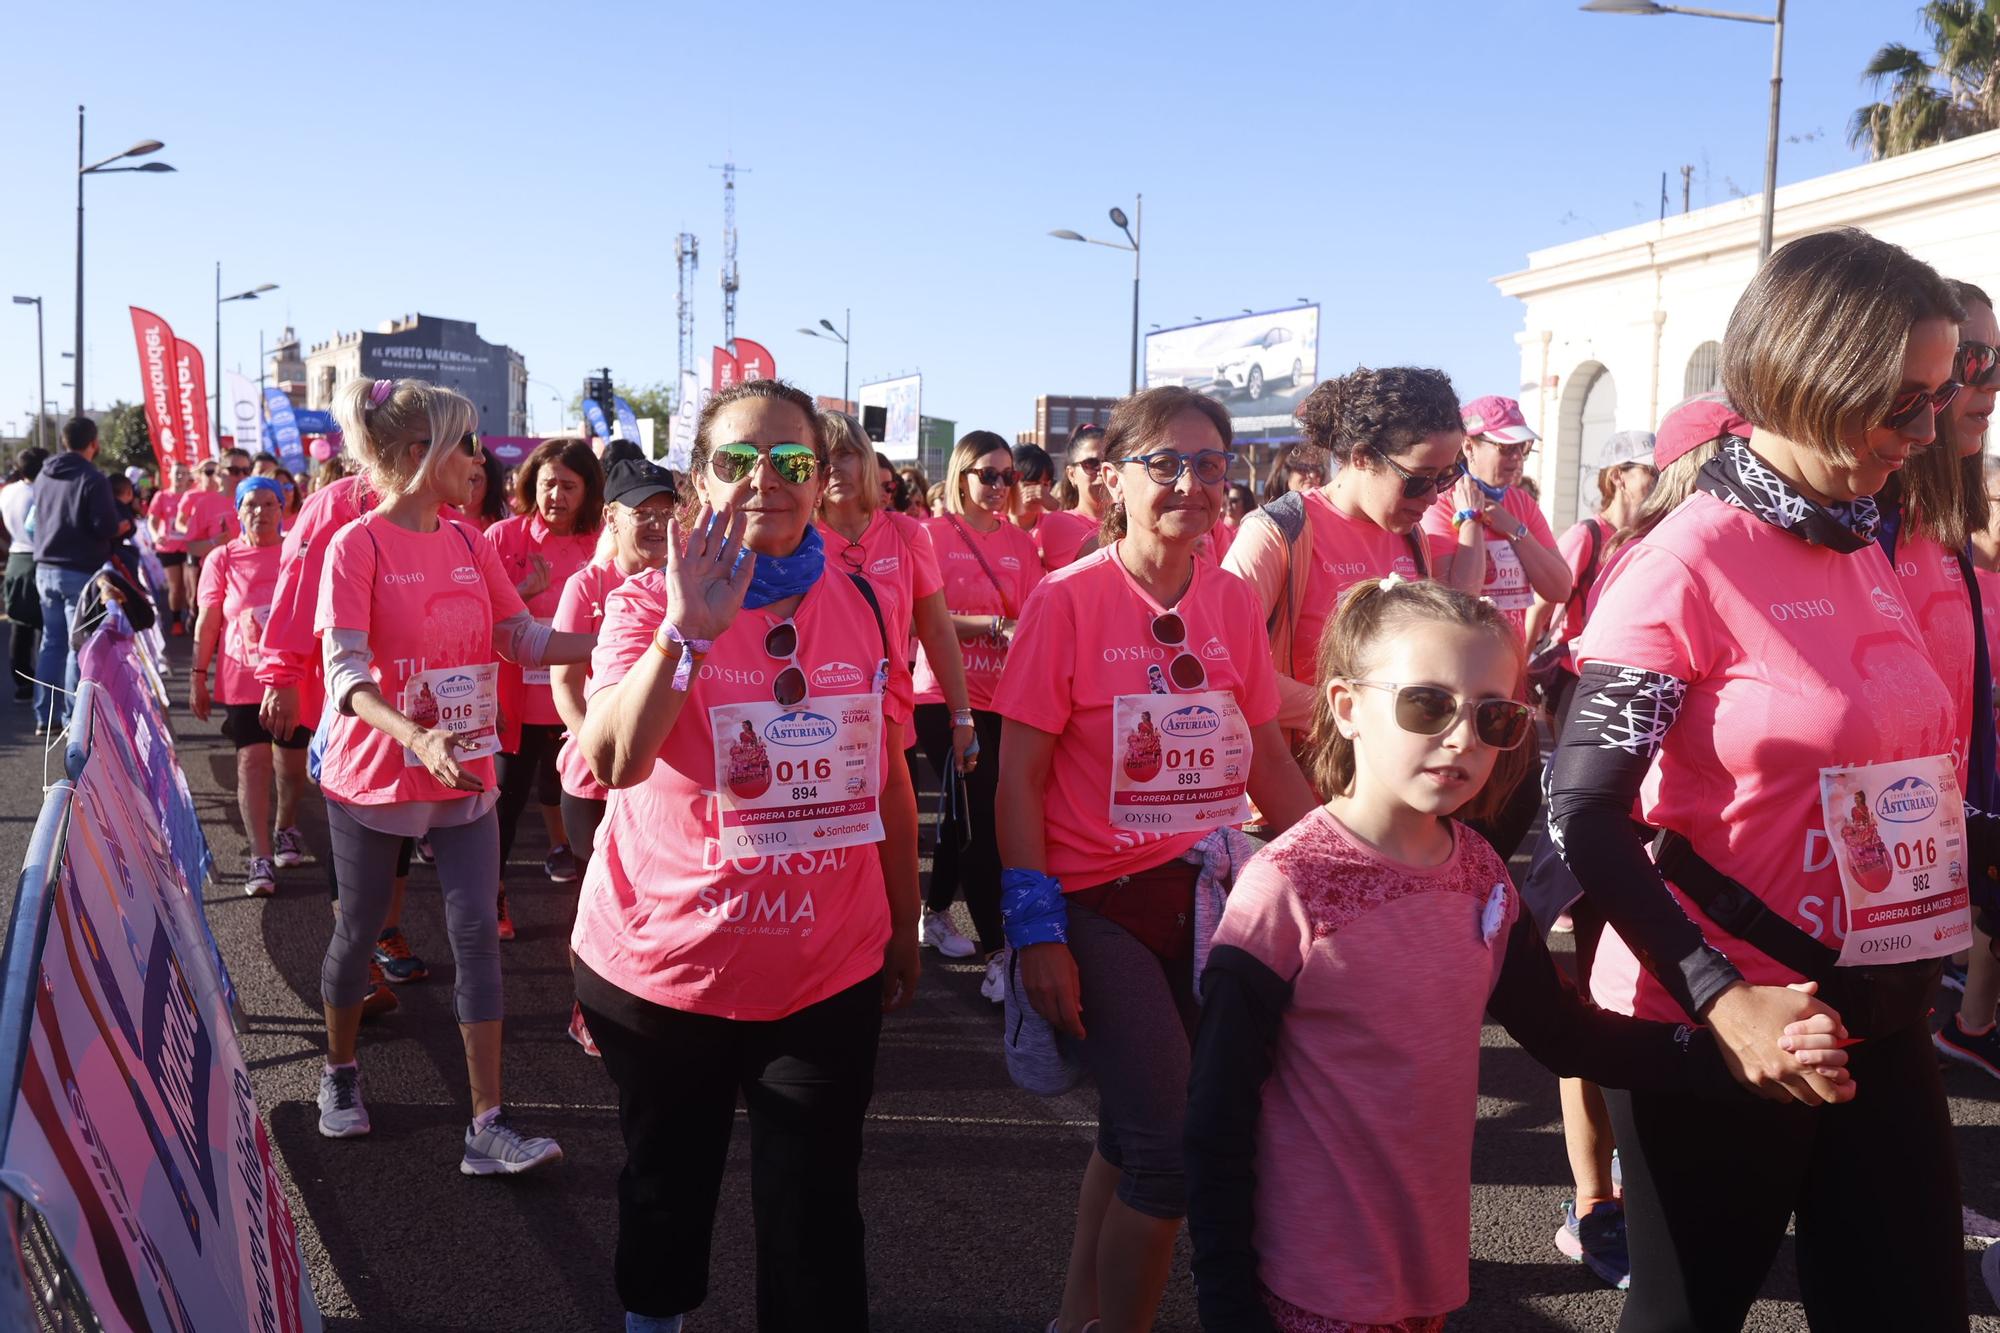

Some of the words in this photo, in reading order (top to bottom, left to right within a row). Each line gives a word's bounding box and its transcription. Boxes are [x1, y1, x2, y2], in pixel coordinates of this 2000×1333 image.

[384, 346, 424, 360] PUERTO
[1323, 560, 1366, 575] OYSHO
[1500, 567, 1520, 577] 016
[1770, 598, 1835, 622] OYSHO
[961, 654, 1009, 672] UMA
[1103, 646, 1165, 663] OYSHO
[699, 664, 765, 686] OYSHO
[815, 672, 863, 686] ASTURIANA
[442, 704, 473, 720] 016
[842, 715, 870, 725] SUMA
[447, 721, 468, 731] 6103
[771, 725, 832, 739] ASTURIANA
[1166, 718, 1217, 731] ASTURIANA
[1166, 748, 1215, 768] 016
[776, 758, 832, 782] 016
[1178, 772, 1201, 785] 893
[792, 786, 818, 800] 894
[1130, 794, 1171, 803] CARRERA
[1173, 793, 1185, 801] DE
[1187, 792, 1197, 800] LA
[1198, 791, 1223, 800] MUJER
[740, 810, 785, 822] CARRERA
[788, 809, 800, 818] DE
[803, 808, 814, 816] LA
[816, 805, 845, 815] MUJER
[848, 802, 866, 811] 2023
[1881, 796, 1937, 816] ASTURIANA
[1125, 813, 1172, 824] OYSHO
[737, 831, 787, 846] OYSHO
[827, 822, 870, 837] Santander
[1893, 837, 1937, 870] 016
[1912, 873, 1930, 892] 982
[696, 886, 816, 924] SUMA
[1867, 906, 1910, 923] CARRERA
[1912, 905, 1923, 916] DE
[1923, 903, 1932, 914] LA
[1932, 898, 1952, 912] MUJER
[1860, 934, 1912, 954] OYSHO
[159, 957, 201, 1170] Noraut
